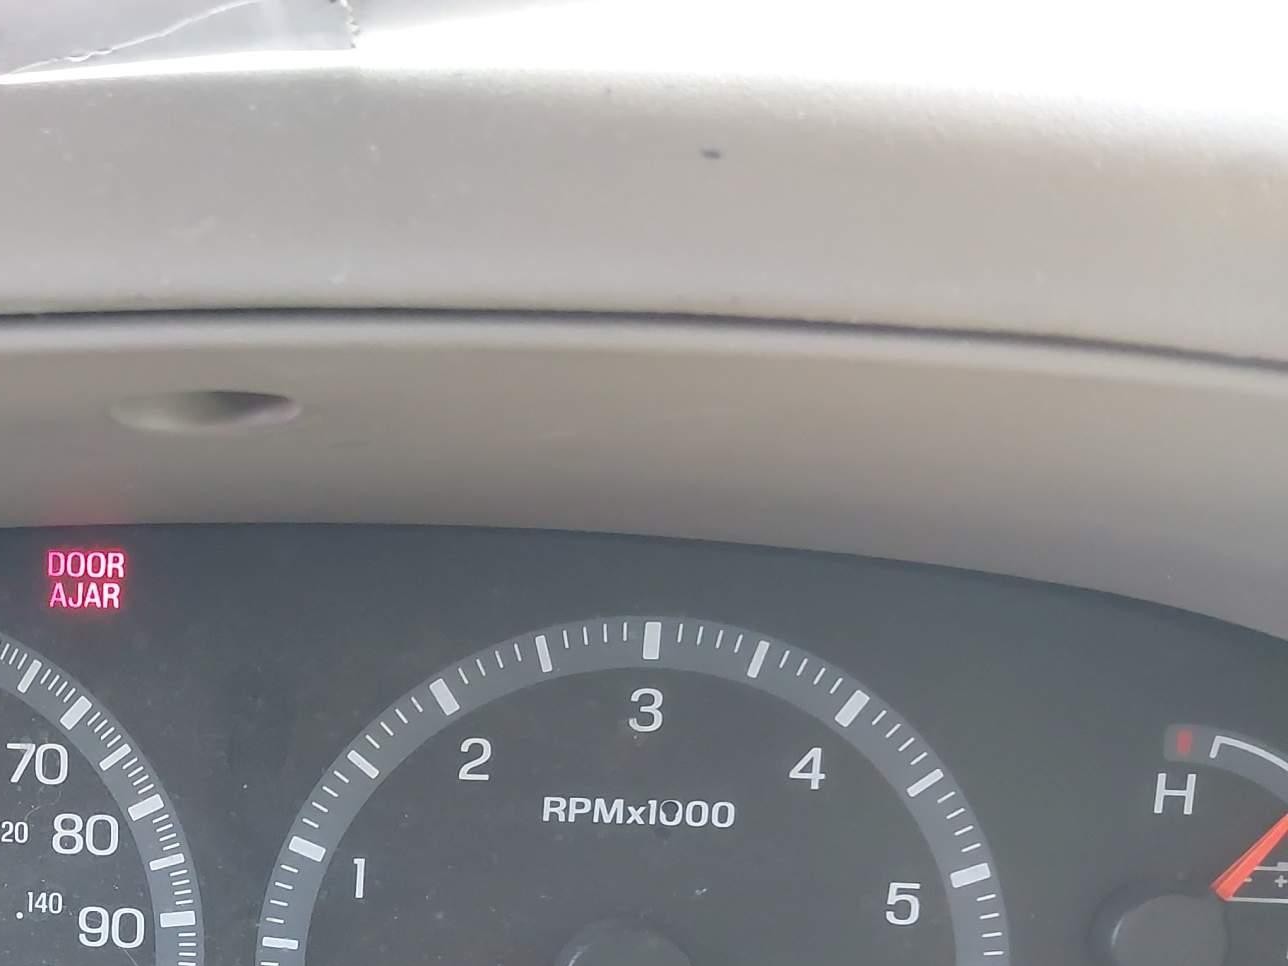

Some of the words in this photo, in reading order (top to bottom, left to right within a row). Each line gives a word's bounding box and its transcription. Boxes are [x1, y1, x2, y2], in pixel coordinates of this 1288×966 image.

[48, 552, 124, 578] DOOR
[50, 582, 120, 608] AJAR
[629, 688, 663, 731] 3
[7, 743, 67, 784] 70
[459, 738, 491, 780] 2
[789, 748, 825, 789] 4
[543, 797, 734, 827] RPMx1000
[1154, 773, 1196, 814] H
[53, 814, 118, 855] 80
[354, 859, 365, 898] 1
[28, 892, 62, 913] 140
[886, 883, 920, 925] 5
[79, 907, 144, 948] 90
